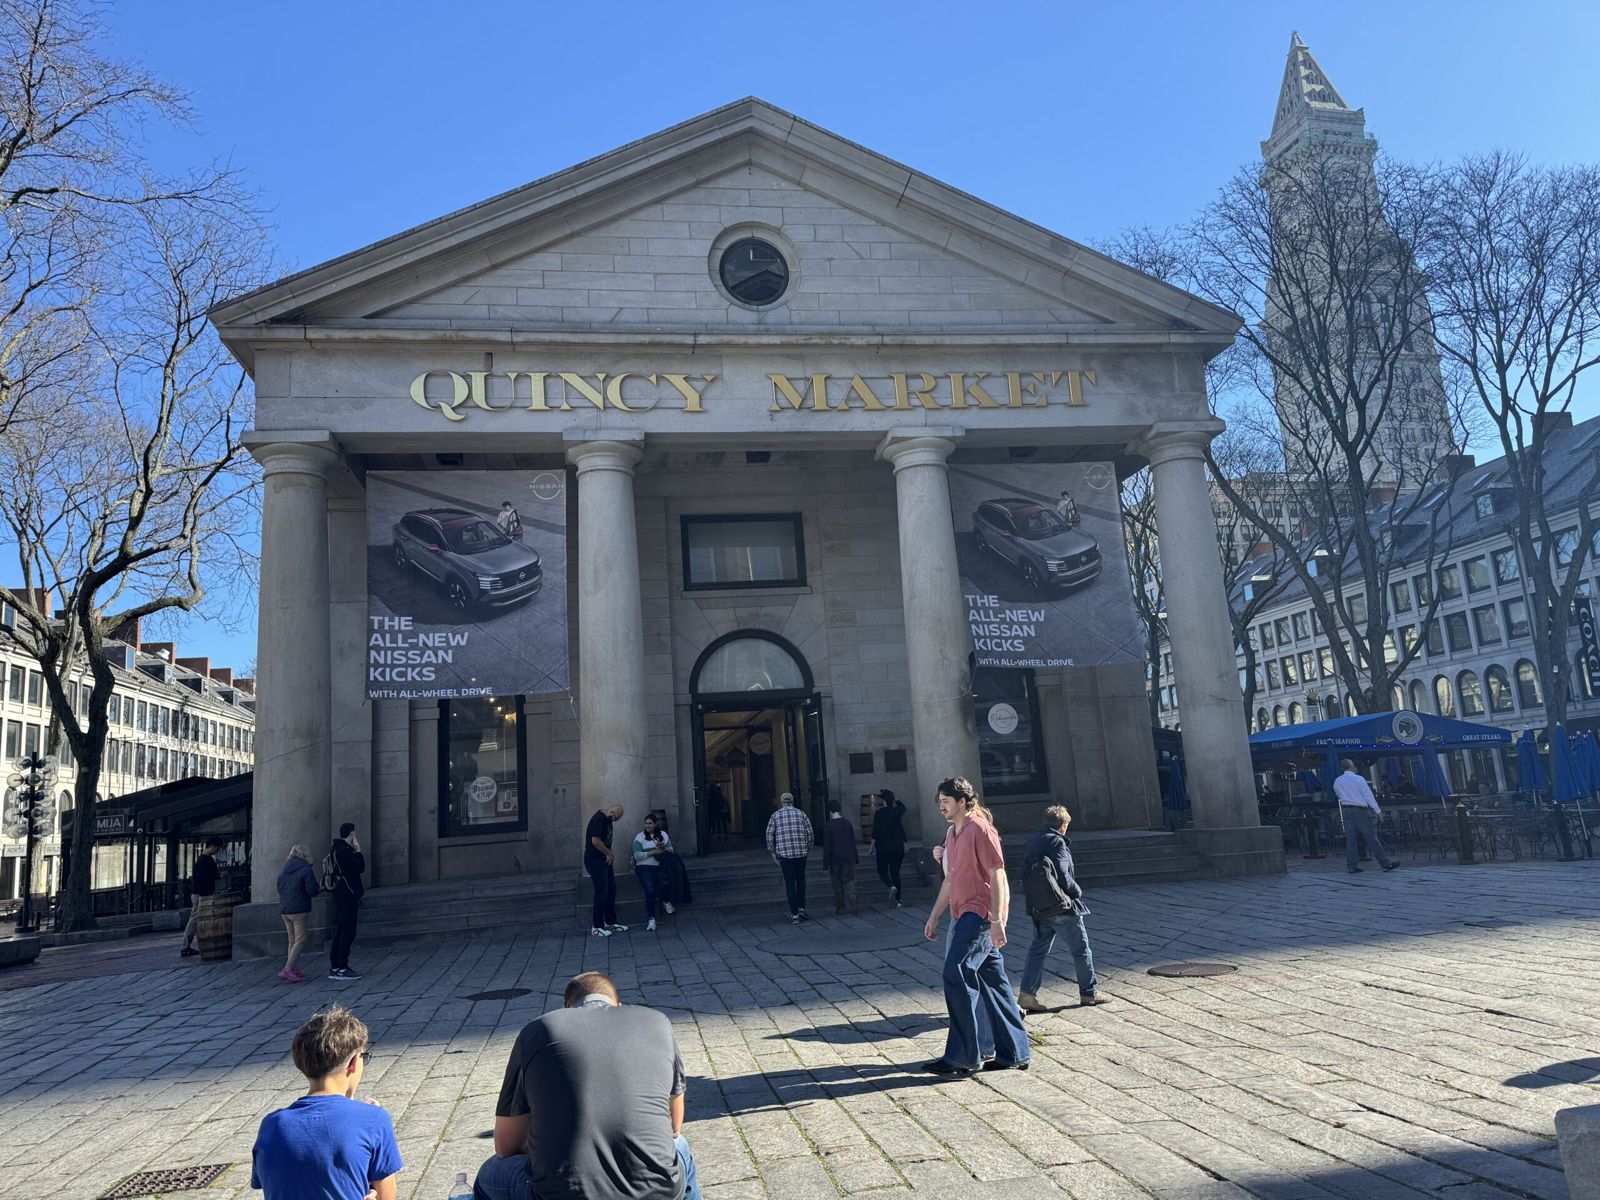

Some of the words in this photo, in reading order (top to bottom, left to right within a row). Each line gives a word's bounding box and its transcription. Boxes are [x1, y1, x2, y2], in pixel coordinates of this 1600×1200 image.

[409, 370, 719, 421] QUINCY
[767, 371, 1098, 411] MARKET
[965, 594, 1000, 607] THE
[968, 609, 1045, 622] ALL-NEW
[369, 615, 413, 631] THE
[971, 624, 1036, 637] NISSAN
[369, 632, 469, 647] ALL-NEW
[974, 638, 1026, 652] KICKS
[1580, 607, 1600, 687] COACH
[369, 649, 453, 664] NISSAN
[978, 657, 999, 666] WITH
[1001, 658, 1046, 667] ALL-WHEEL
[1047, 658, 1073, 667] DRIVE
[369, 667, 436, 682] KICKS
[369, 690, 398, 698] WITH
[399, 688, 460, 698] ALL-WHEEL
[461, 686, 493, 696] DRIVE
[96, 818, 121, 829] MIJA
